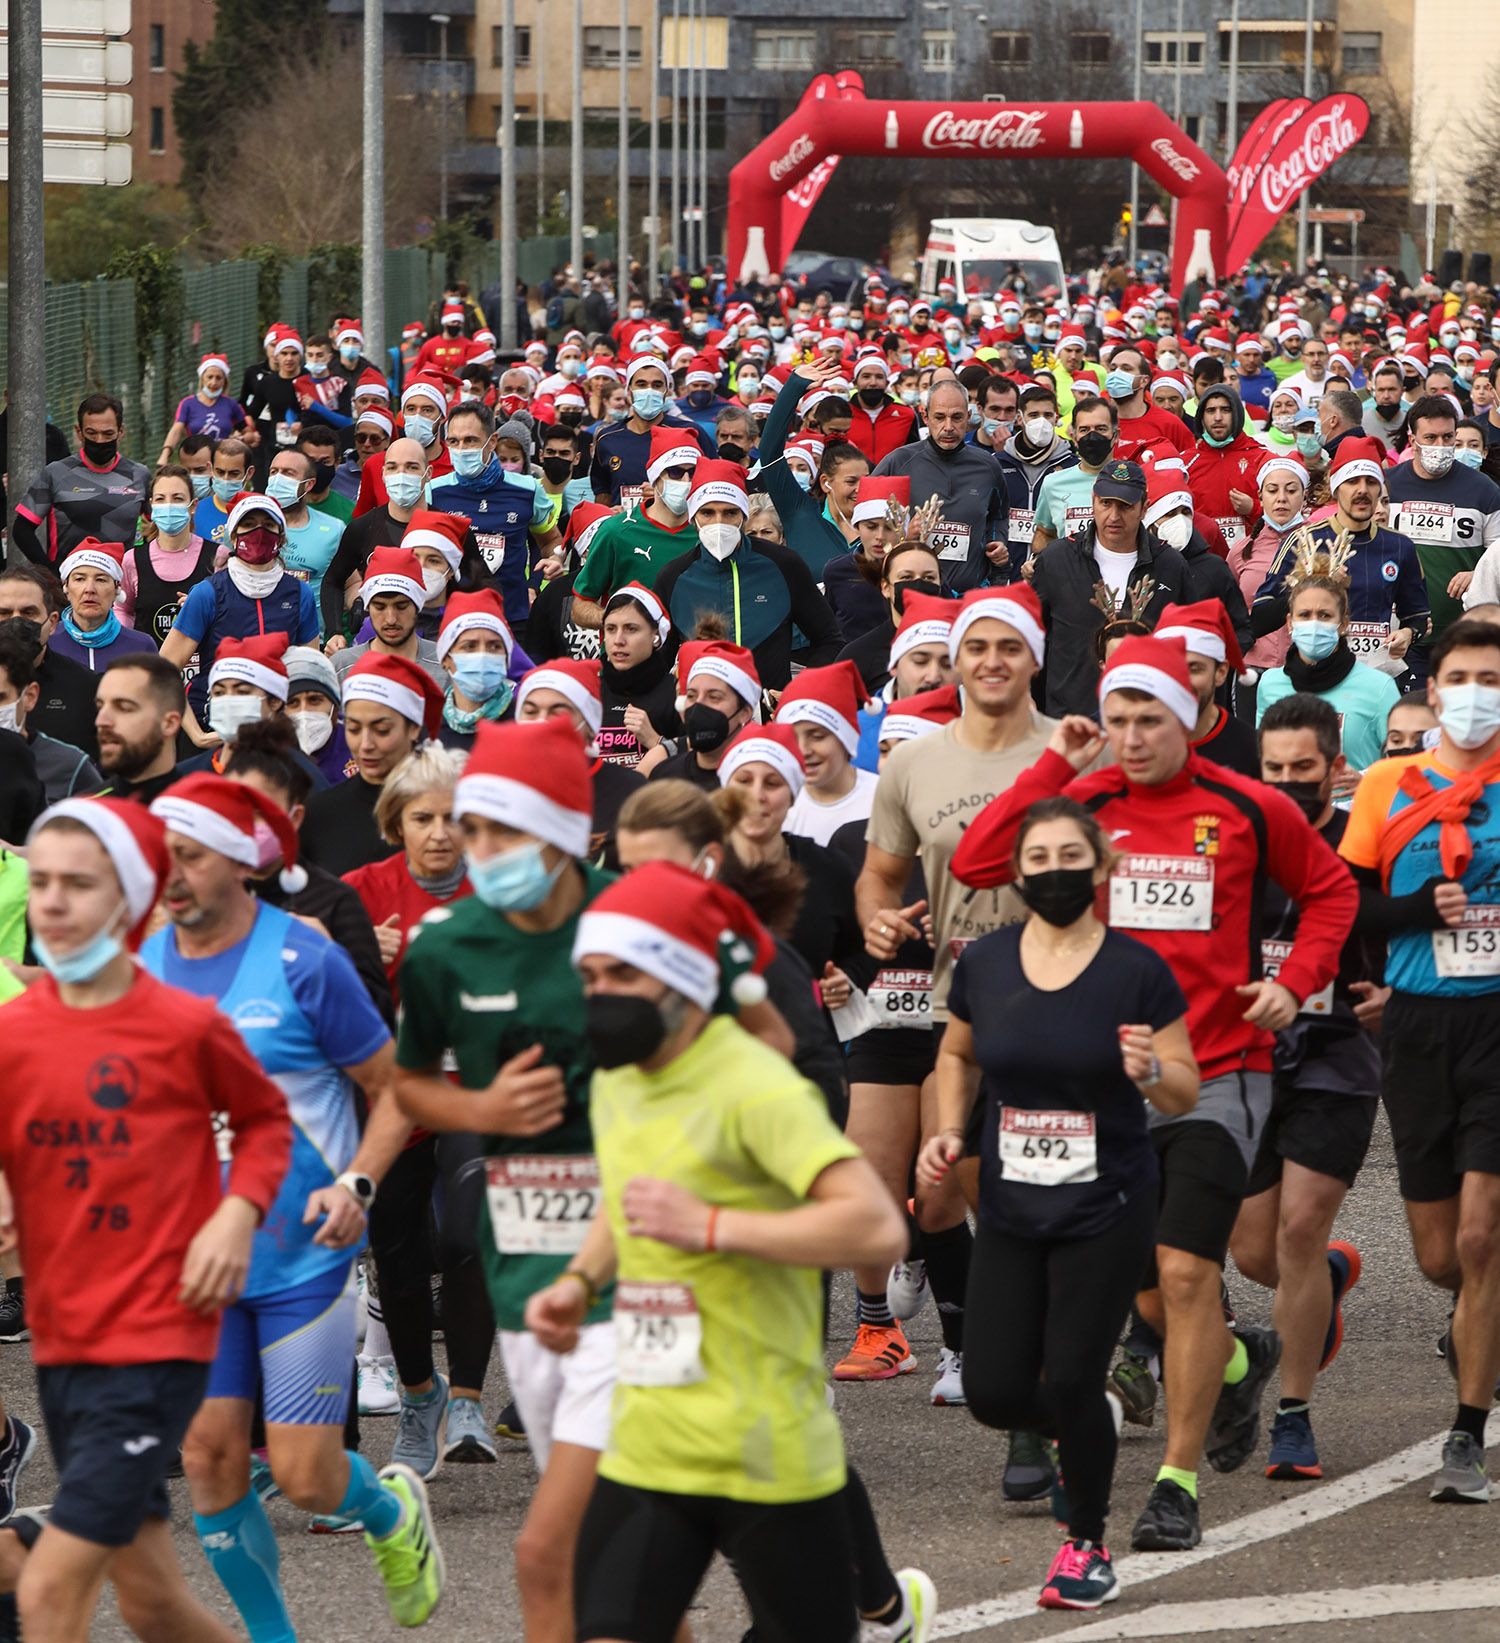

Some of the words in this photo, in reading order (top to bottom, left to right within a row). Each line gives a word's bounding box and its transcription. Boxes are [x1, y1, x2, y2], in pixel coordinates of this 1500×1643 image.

[1411, 502, 1453, 513] MAPFRE
[935, 523, 970, 532] APFRE
[1410, 513, 1445, 529] 1264
[932, 534, 959, 548] 656
[1130, 857, 1210, 876] MAPFRE
[1128, 880, 1195, 907] 1526
[1449, 930, 1500, 954] 153
[886, 991, 930, 1013] 886
[1014, 1112, 1089, 1131] MAPFRE
[26, 1118, 132, 1147] OSAKA
[1022, 1137, 1071, 1161] 692
[513, 1189, 595, 1223] 1222
